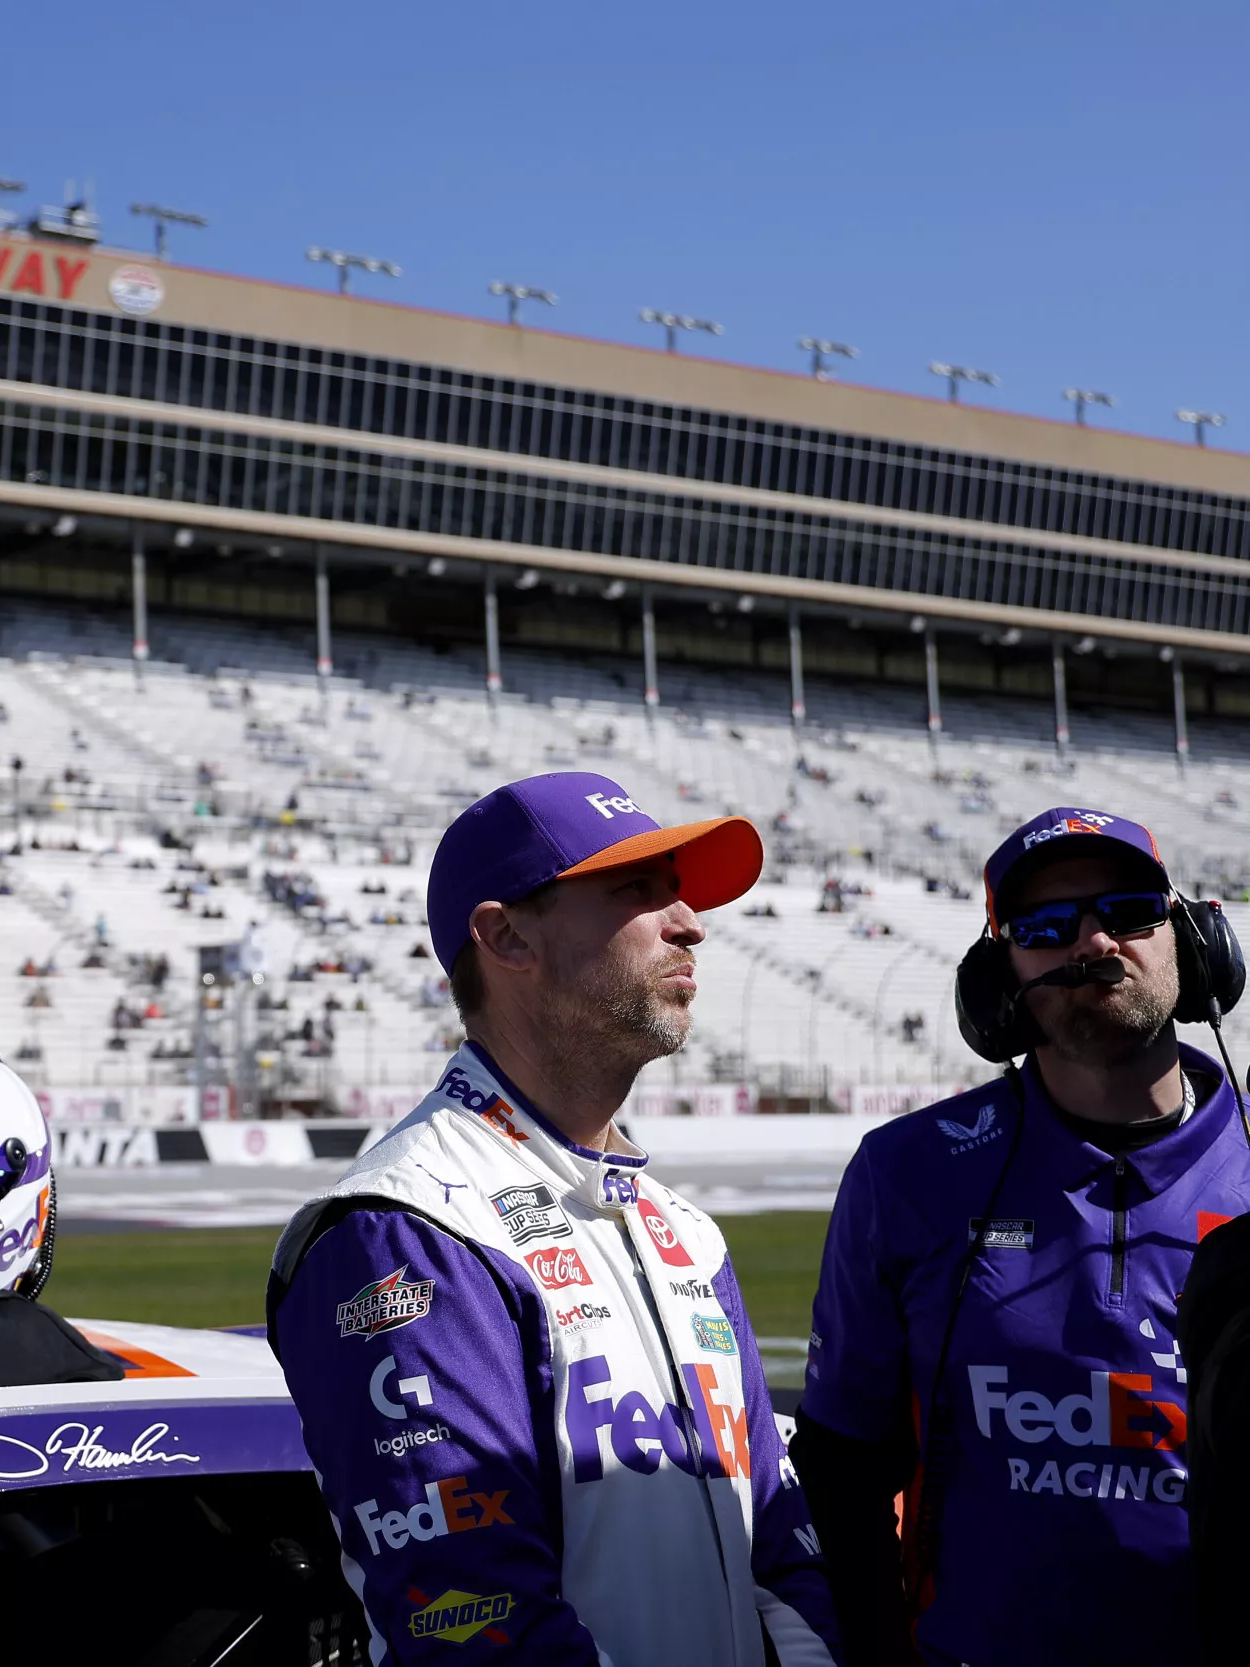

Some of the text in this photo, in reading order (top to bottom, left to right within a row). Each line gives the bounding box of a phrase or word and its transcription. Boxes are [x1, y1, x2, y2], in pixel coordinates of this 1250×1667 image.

[1022, 819, 1103, 850] FedEx
[435, 1067, 530, 1151] FedEx
[950, 1127, 1004, 1156] CASTORE
[993, 1233, 1025, 1243] SERIES
[340, 1284, 430, 1320] INTERSTATE
[345, 1300, 426, 1331] BATTERIES
[565, 1354, 751, 1484] FedEx
[374, 1423, 451, 1457] logitech
[1007, 1457, 1187, 1503] RACING
[353, 1475, 516, 1556] FedEx
[413, 1595, 510, 1635] SUNOCO
